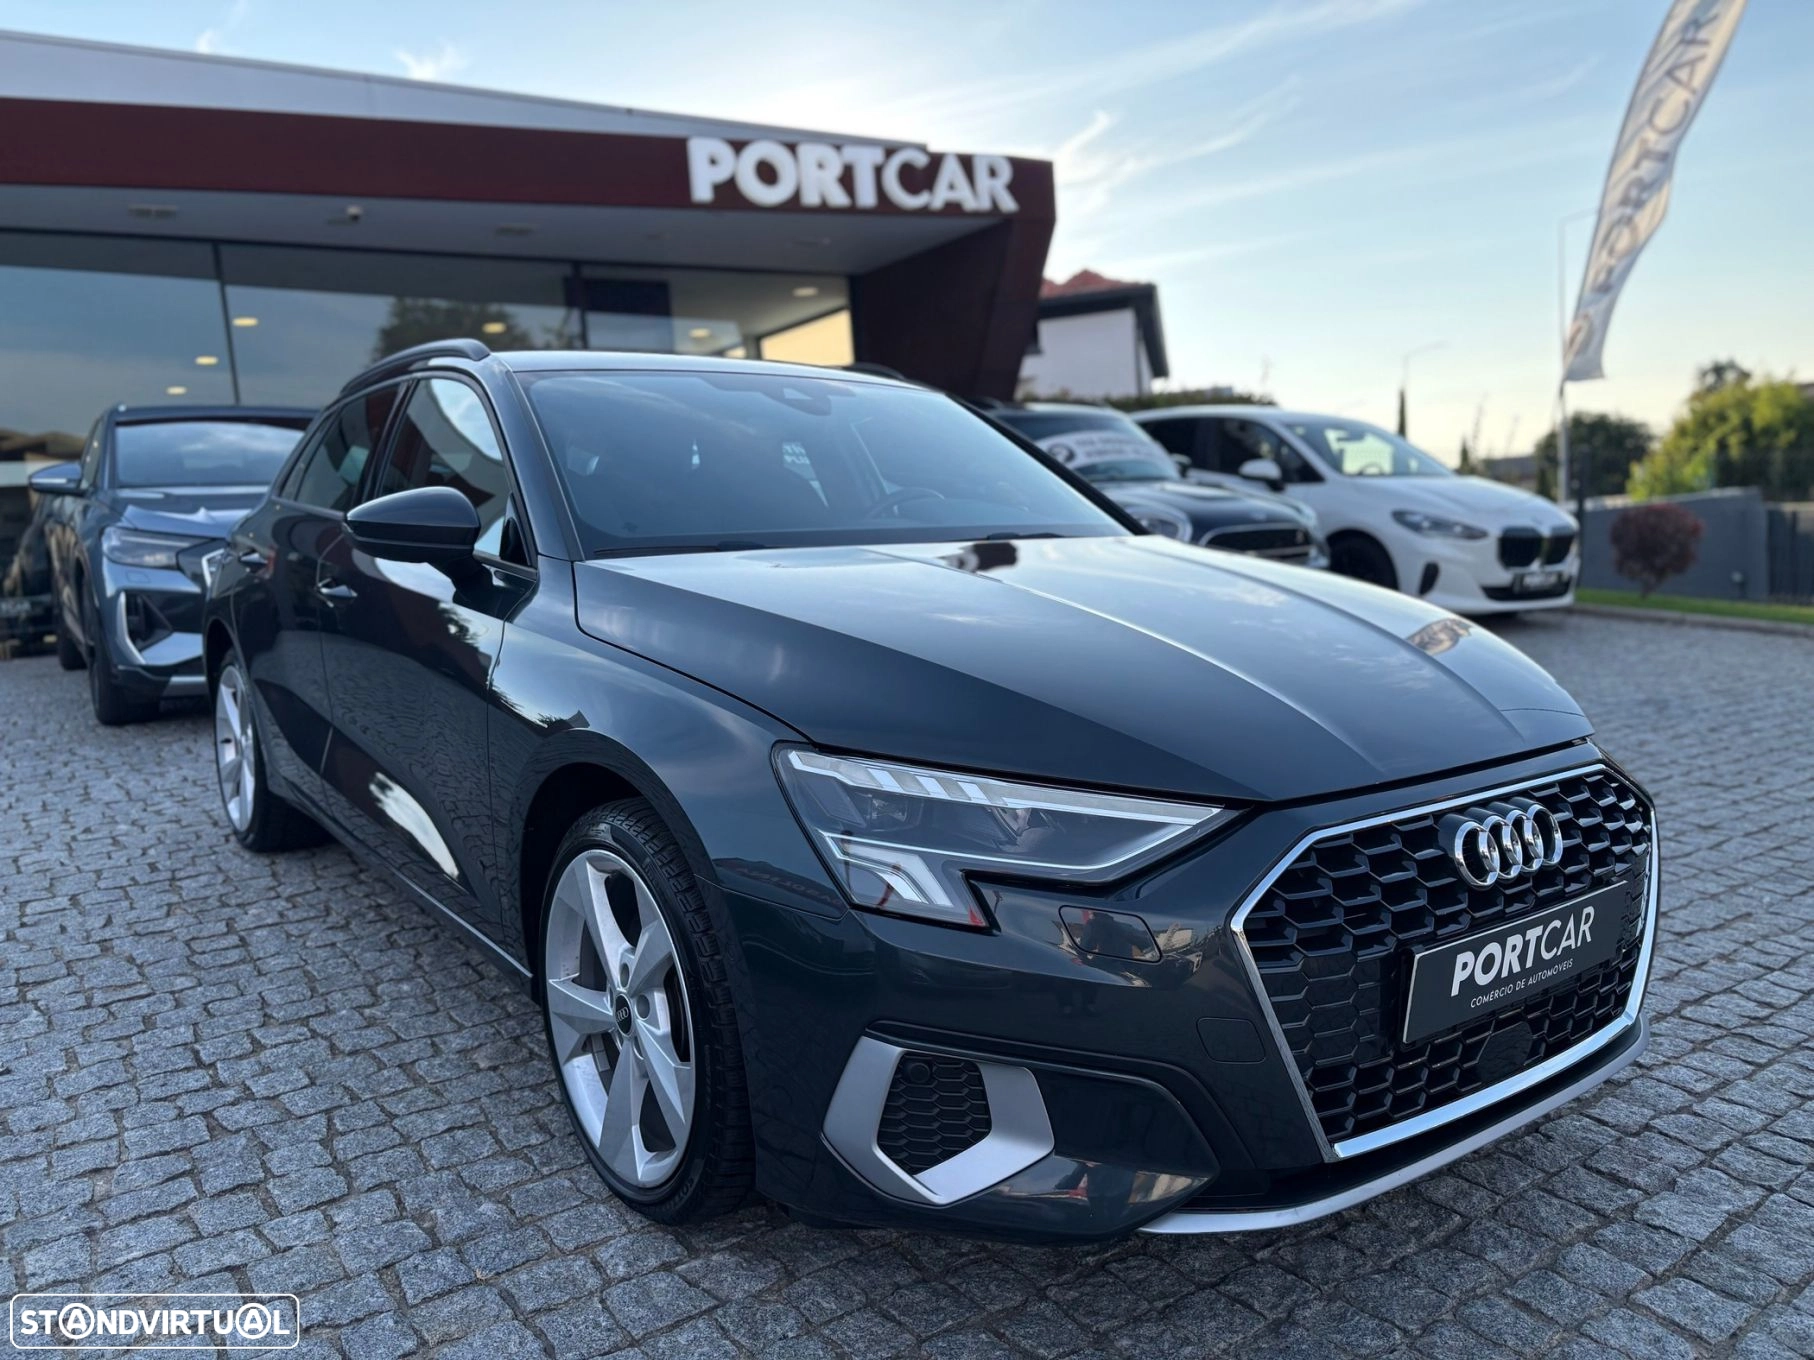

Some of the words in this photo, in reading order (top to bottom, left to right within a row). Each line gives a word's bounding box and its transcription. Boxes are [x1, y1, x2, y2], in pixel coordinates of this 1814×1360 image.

[686, 135, 1019, 213] PORTCAR
[1451, 905, 1595, 997] PORTCAR
[1516, 978, 1526, 990] DE
